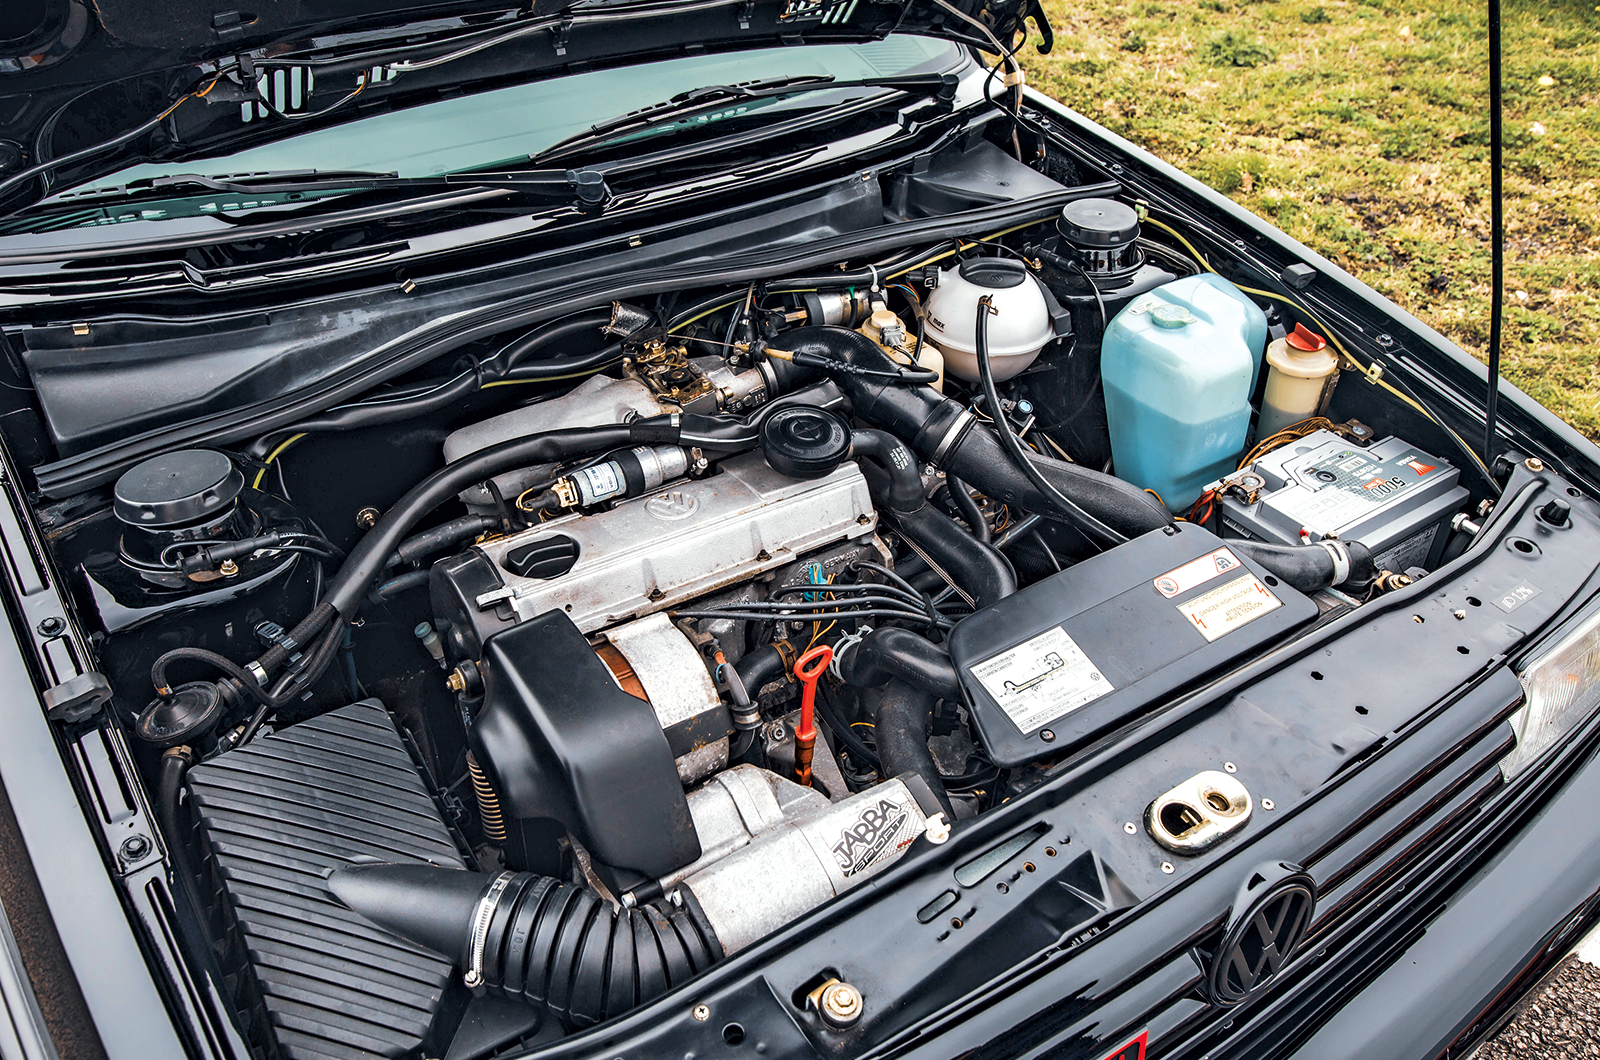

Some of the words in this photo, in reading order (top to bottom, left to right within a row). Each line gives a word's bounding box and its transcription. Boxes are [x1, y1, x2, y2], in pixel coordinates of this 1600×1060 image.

[1369, 476, 1407, 499] 5000
[824, 548, 861, 570] GERMANY
[1198, 602, 1220, 617] DANGER
[1219, 597, 1233, 608] HIGH
[1233, 586, 1255, 600] VOLTAGE
[1225, 601, 1252, 617] ATTENTION
[1225, 609, 1242, 622] HAUTE
[1241, 601, 1263, 616] TENSION
[832, 799, 899, 869] JABBA
